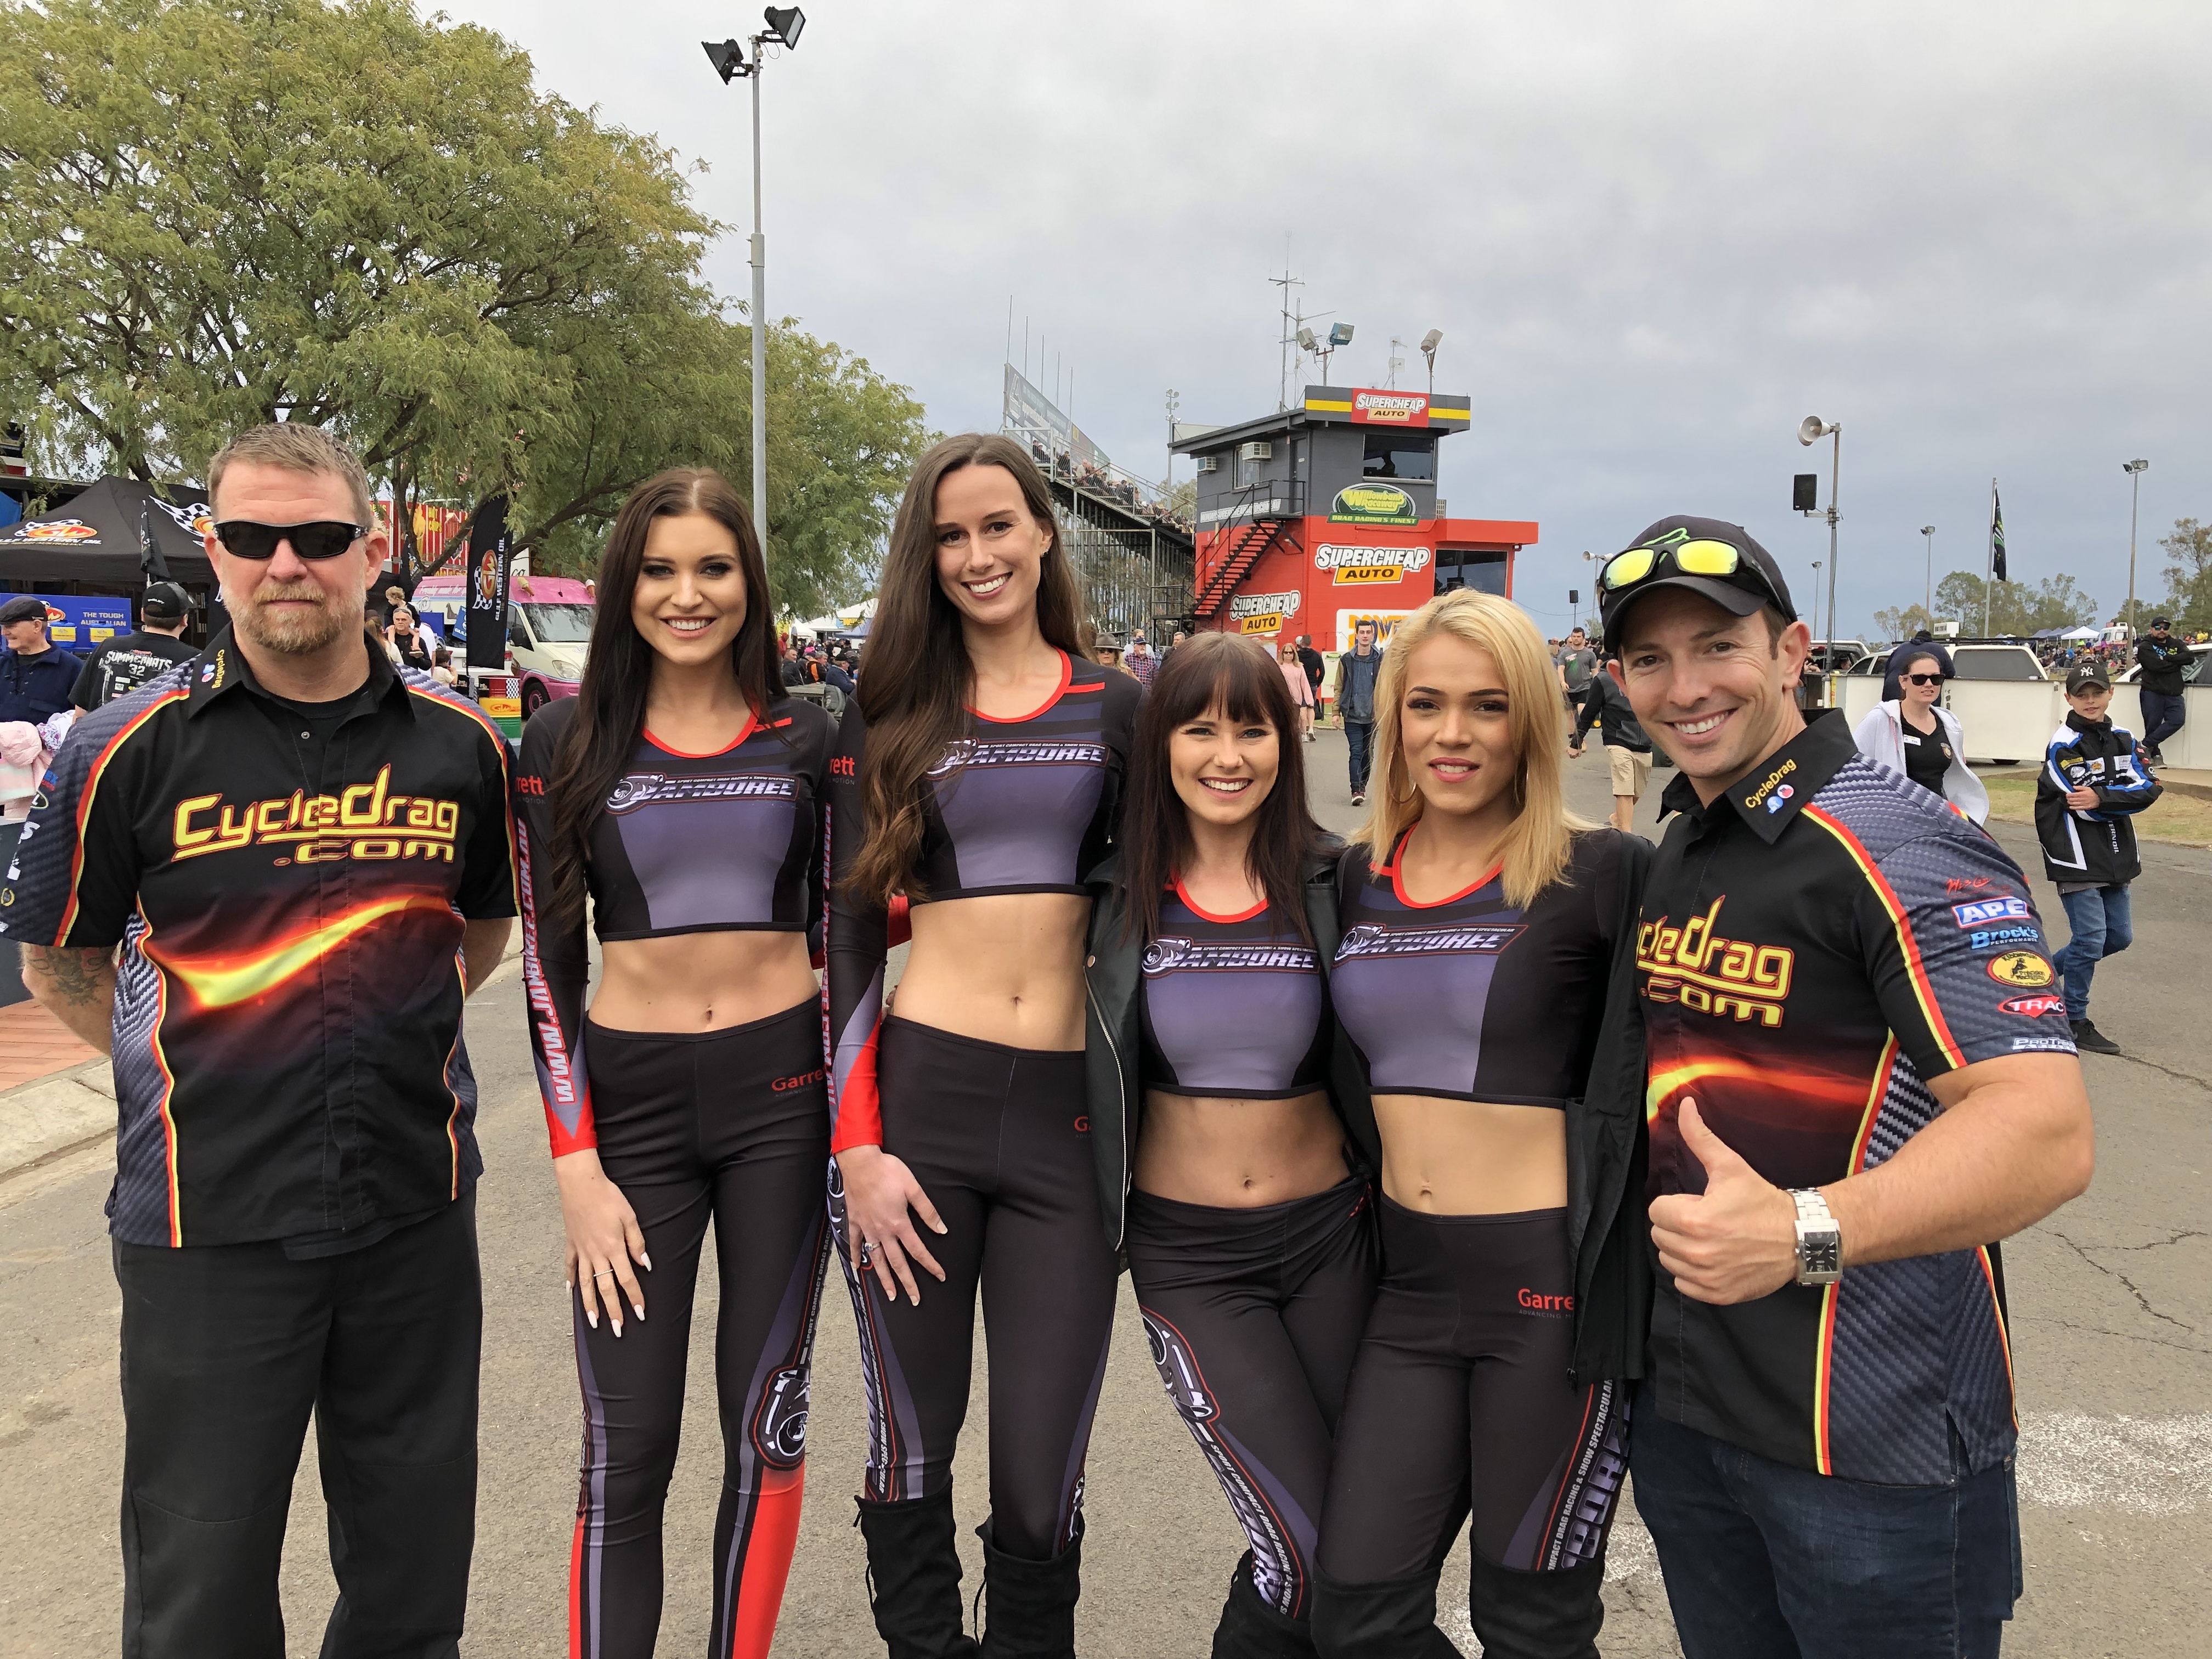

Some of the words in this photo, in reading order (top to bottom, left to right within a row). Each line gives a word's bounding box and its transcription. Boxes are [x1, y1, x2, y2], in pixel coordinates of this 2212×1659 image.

[1357, 394, 1425, 412] SUPERCHEAP
[1316, 545, 1429, 570] SUPERCHEAP
[1345, 569, 1394, 579] AUTO
[1231, 592, 1300, 619] SUPERCHEAP
[1247, 617, 1276, 629] AUTO
[105, 651, 173, 672] SUMMERNATS
[128, 663, 145, 676] 32
[211, 649, 225, 689] CycleDrag
[830, 755, 855, 776] rett
[1745, 759, 1797, 808] CycleDrag
[1962, 900, 2025, 923] APE
[1971, 926, 2039, 950] Brock's
[771, 1069, 823, 1091] Garre
[806, 1318, 814, 1344] SPORT
[811, 1277, 821, 1317] COMPACT
[1518, 1288, 1574, 1311] Garre
[1210, 1444, 1235, 1472] SPORT
[1231, 1472, 1265, 1515] COMPACT
[1260, 1515, 1279, 1541] DRAG
[1556, 1516, 1569, 1539] DRAG
[1563, 1484, 1580, 1517] RACING
[1578, 1448, 1595, 1476] SHOW
